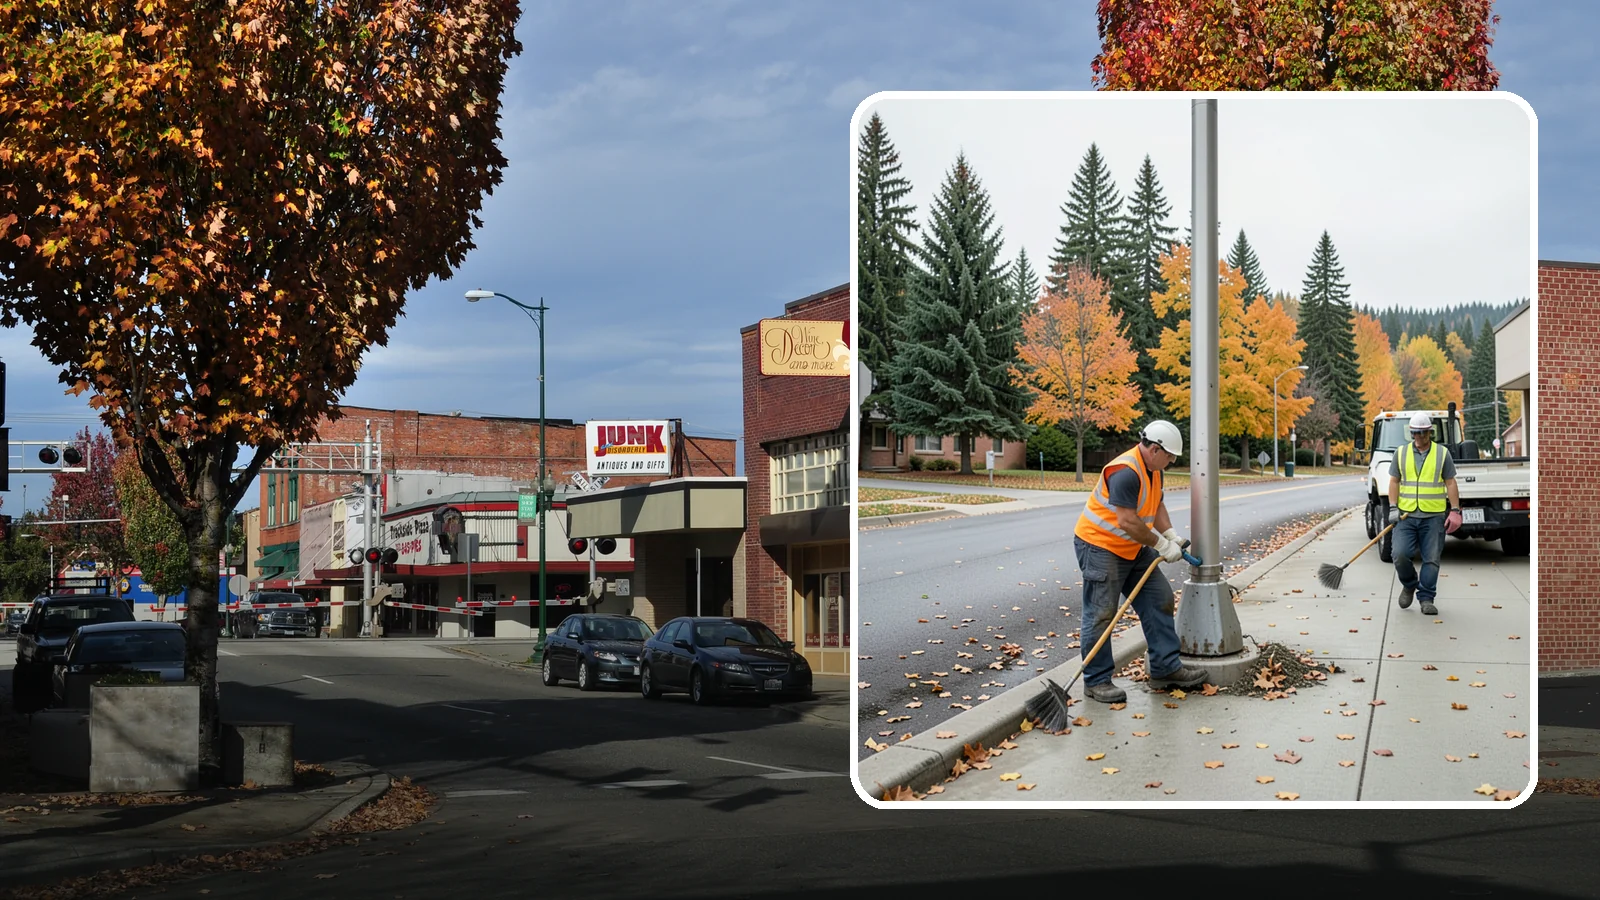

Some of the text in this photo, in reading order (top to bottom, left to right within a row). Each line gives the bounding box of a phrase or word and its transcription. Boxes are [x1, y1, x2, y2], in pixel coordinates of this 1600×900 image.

[596, 425, 665, 457] JUNK
[608, 446, 646, 454] DISORDERLY
[597, 461, 665, 470] ANTIQUES AND GIFTS
[414, 519, 429, 535] Pizza
